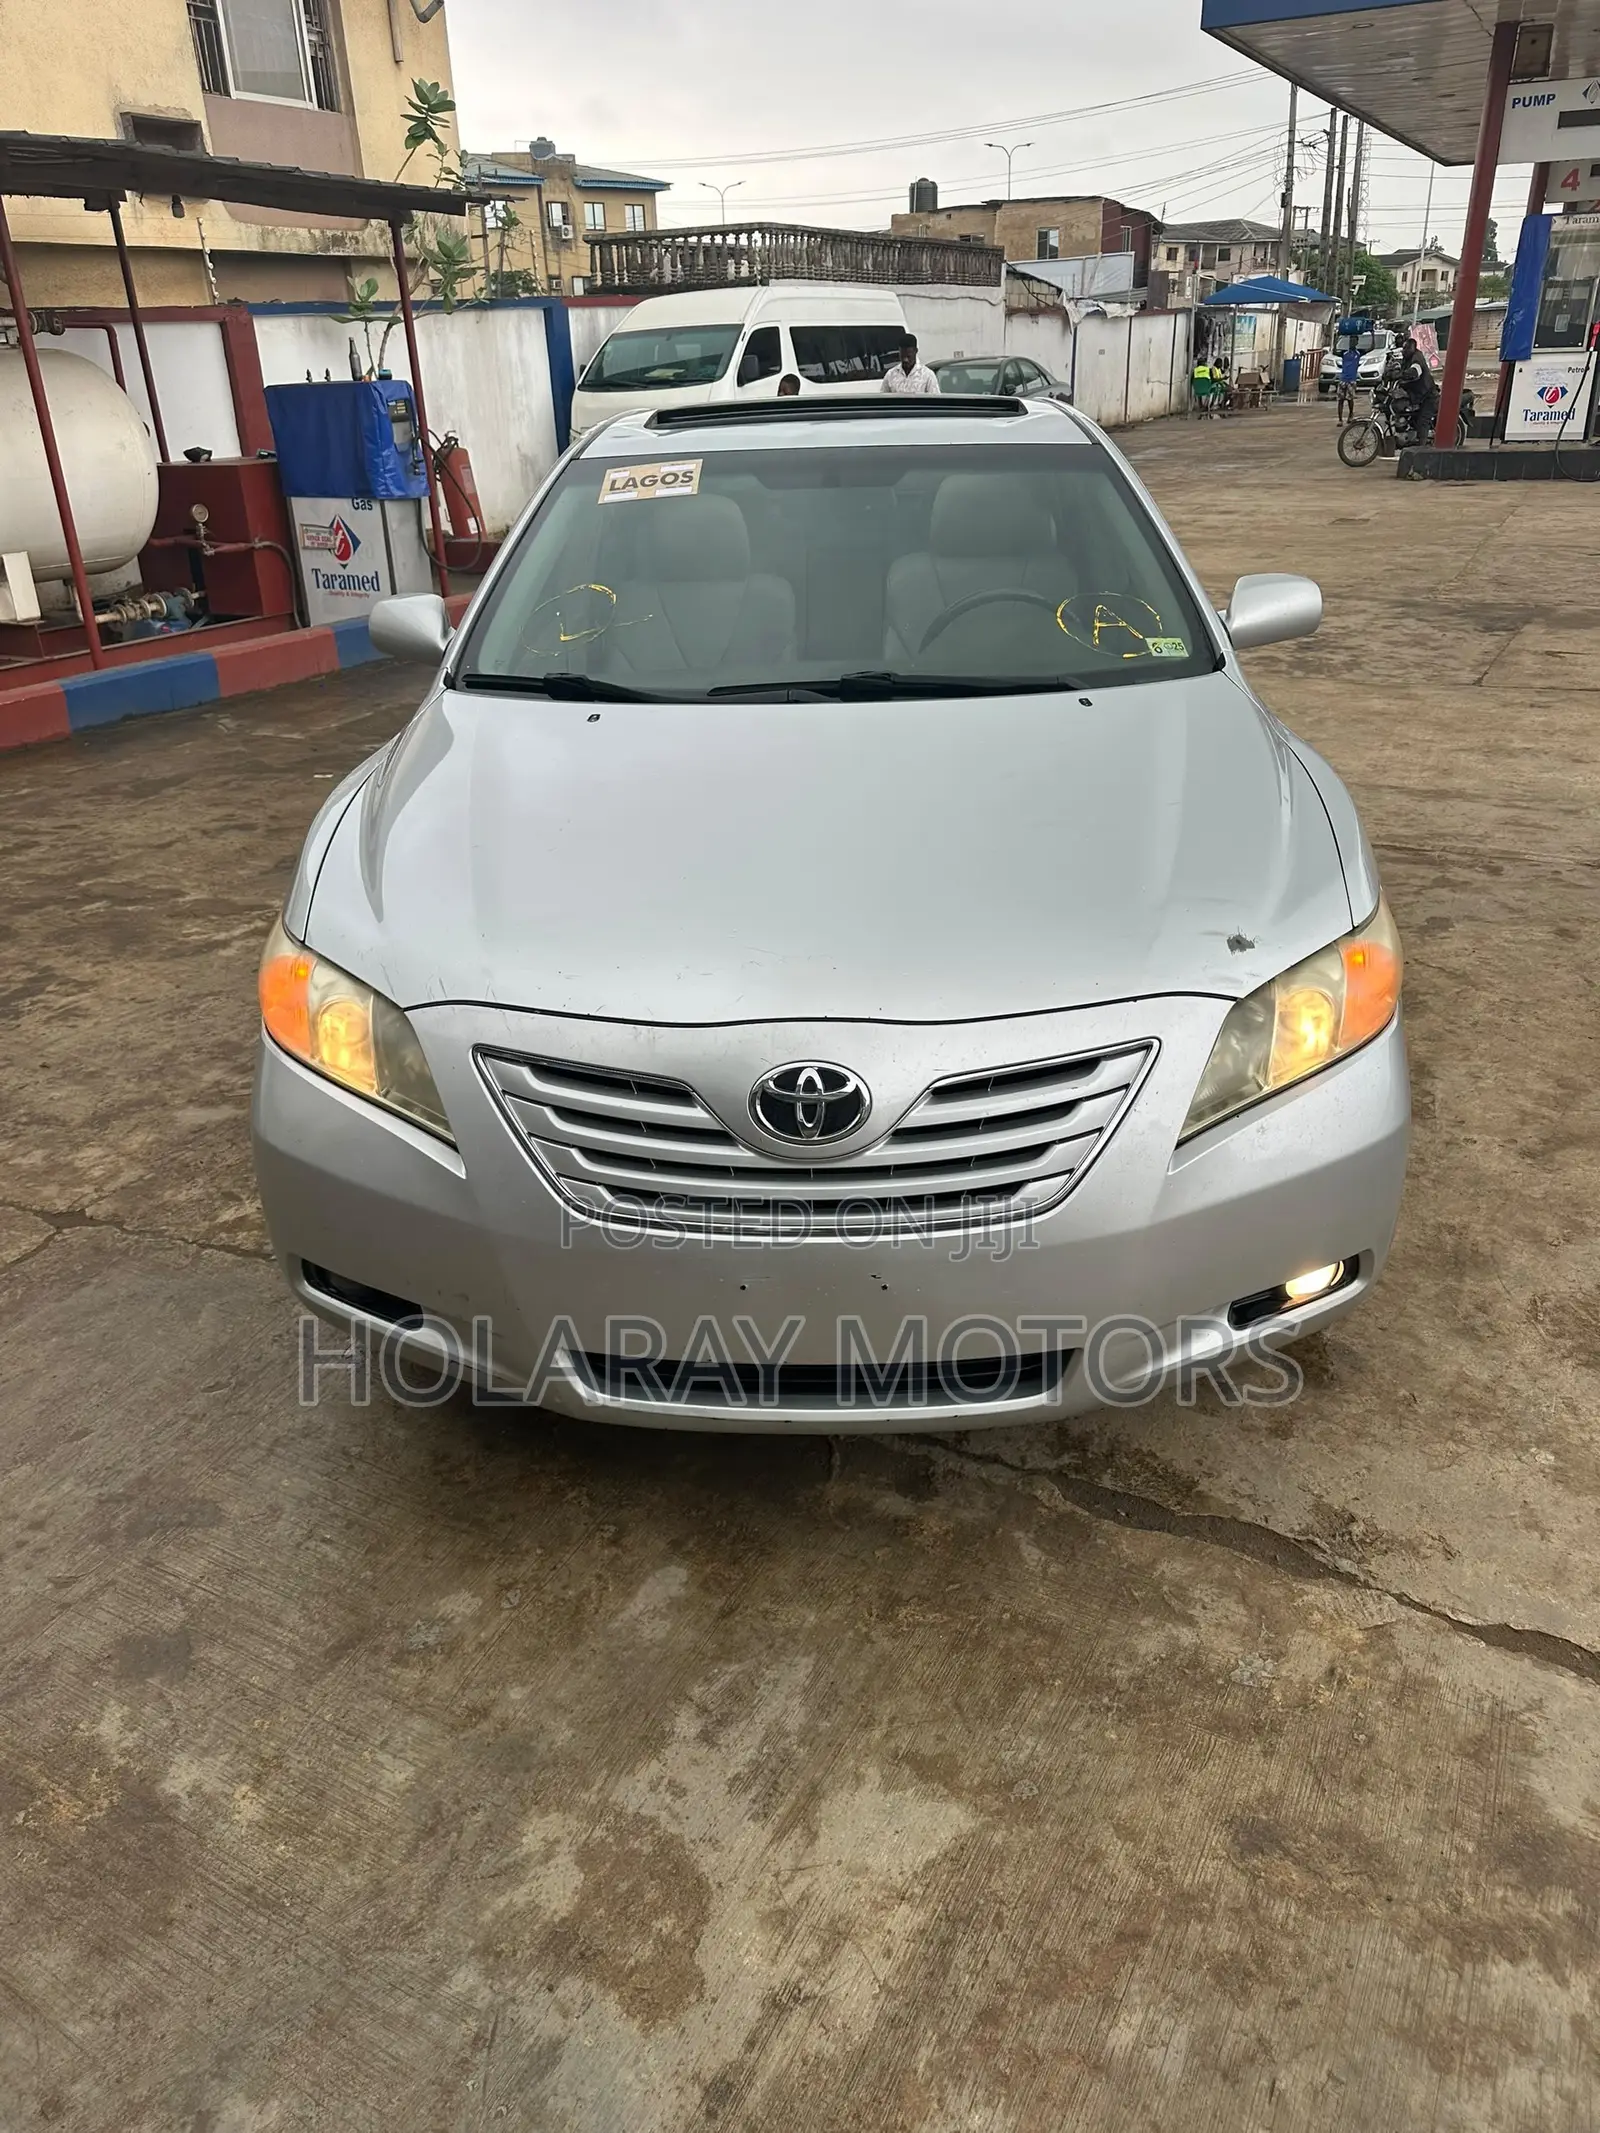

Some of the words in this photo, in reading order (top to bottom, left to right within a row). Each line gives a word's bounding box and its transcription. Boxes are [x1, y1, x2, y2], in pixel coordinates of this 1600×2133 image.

[1511, 93, 1556, 109] PUMP
[1561, 168, 1581, 192] 4
[1567, 366, 1588, 374] Petro
[1523, 408, 1576, 422] Taramed
[609, 470, 694, 492] LAGOS
[352, 497, 373, 511] Gas
[311, 568, 381, 592] Taramed
[1172, 642, 1185, 651] 25
